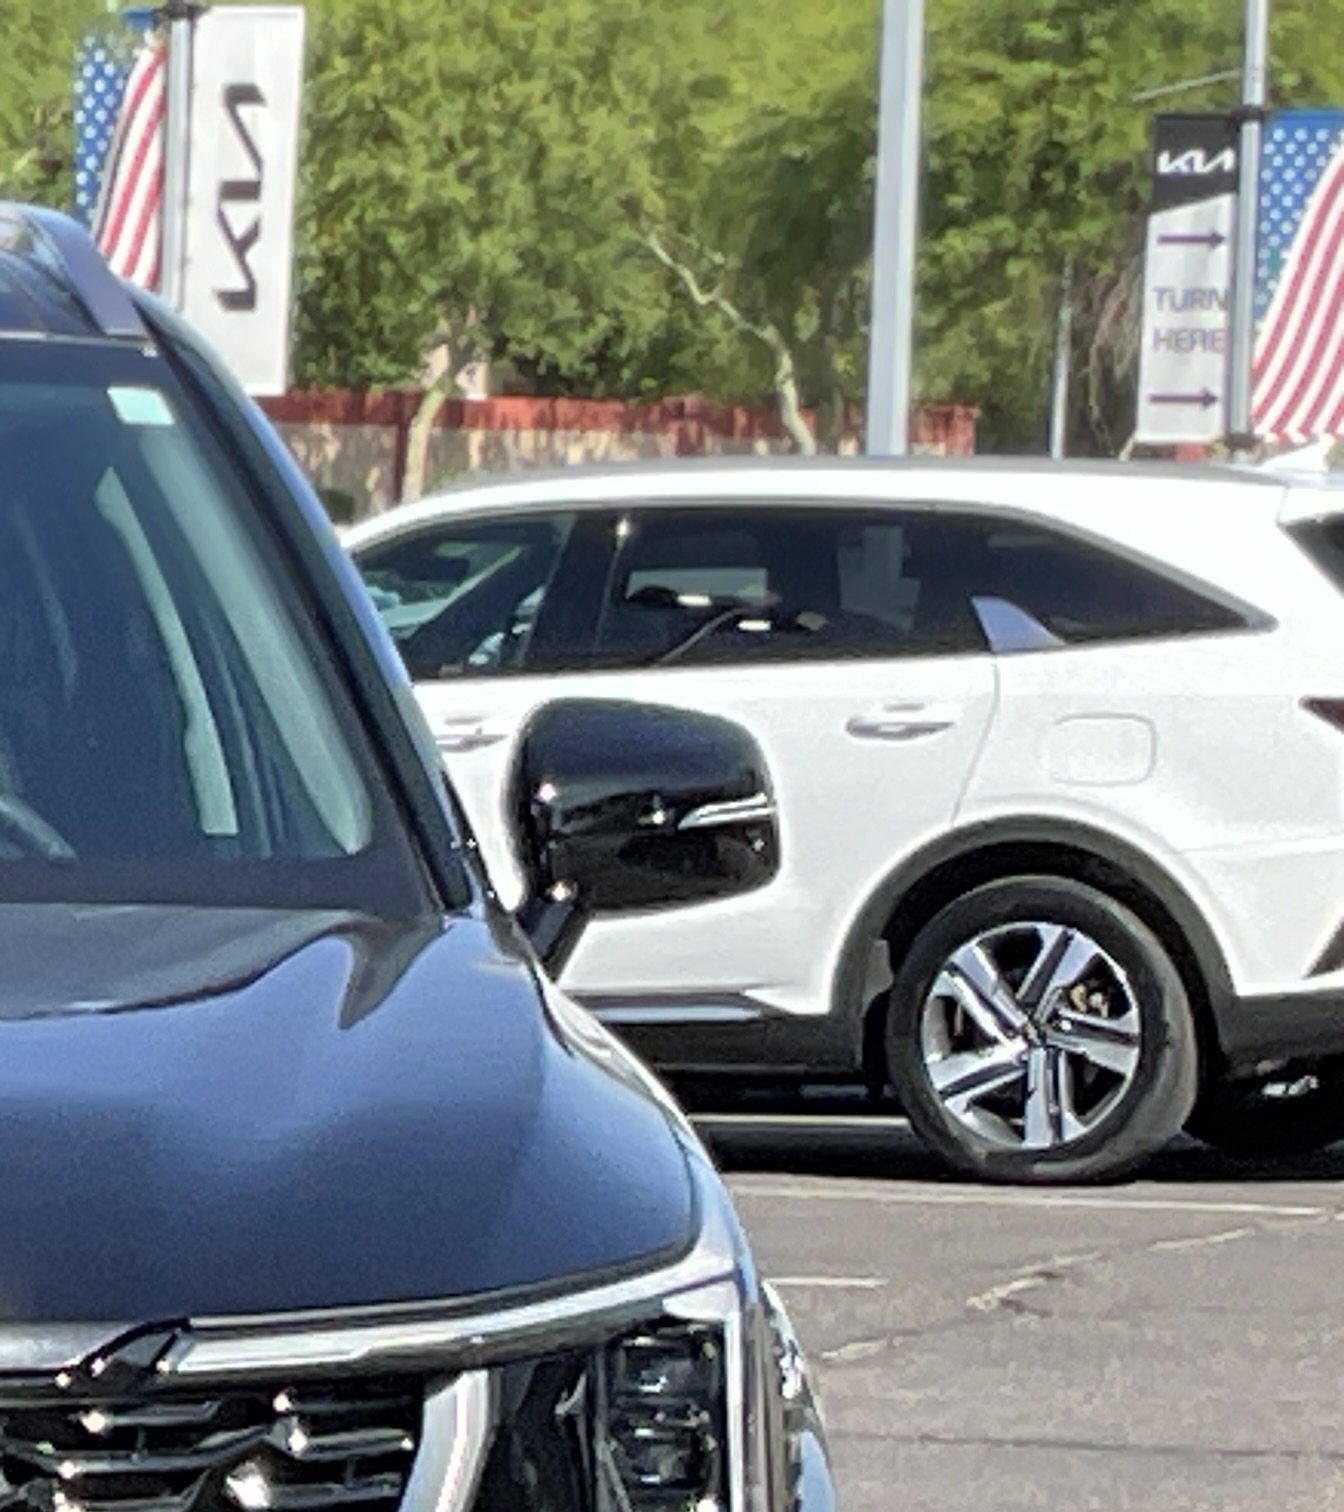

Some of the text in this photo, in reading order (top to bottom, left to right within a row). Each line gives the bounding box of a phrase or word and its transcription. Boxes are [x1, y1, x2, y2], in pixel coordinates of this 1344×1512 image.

[1157, 148, 1236, 174] KIA
[213, 83, 267, 312] KIA
[1152, 287, 1230, 313] TURN
[1152, 328, 1227, 354] HERE
